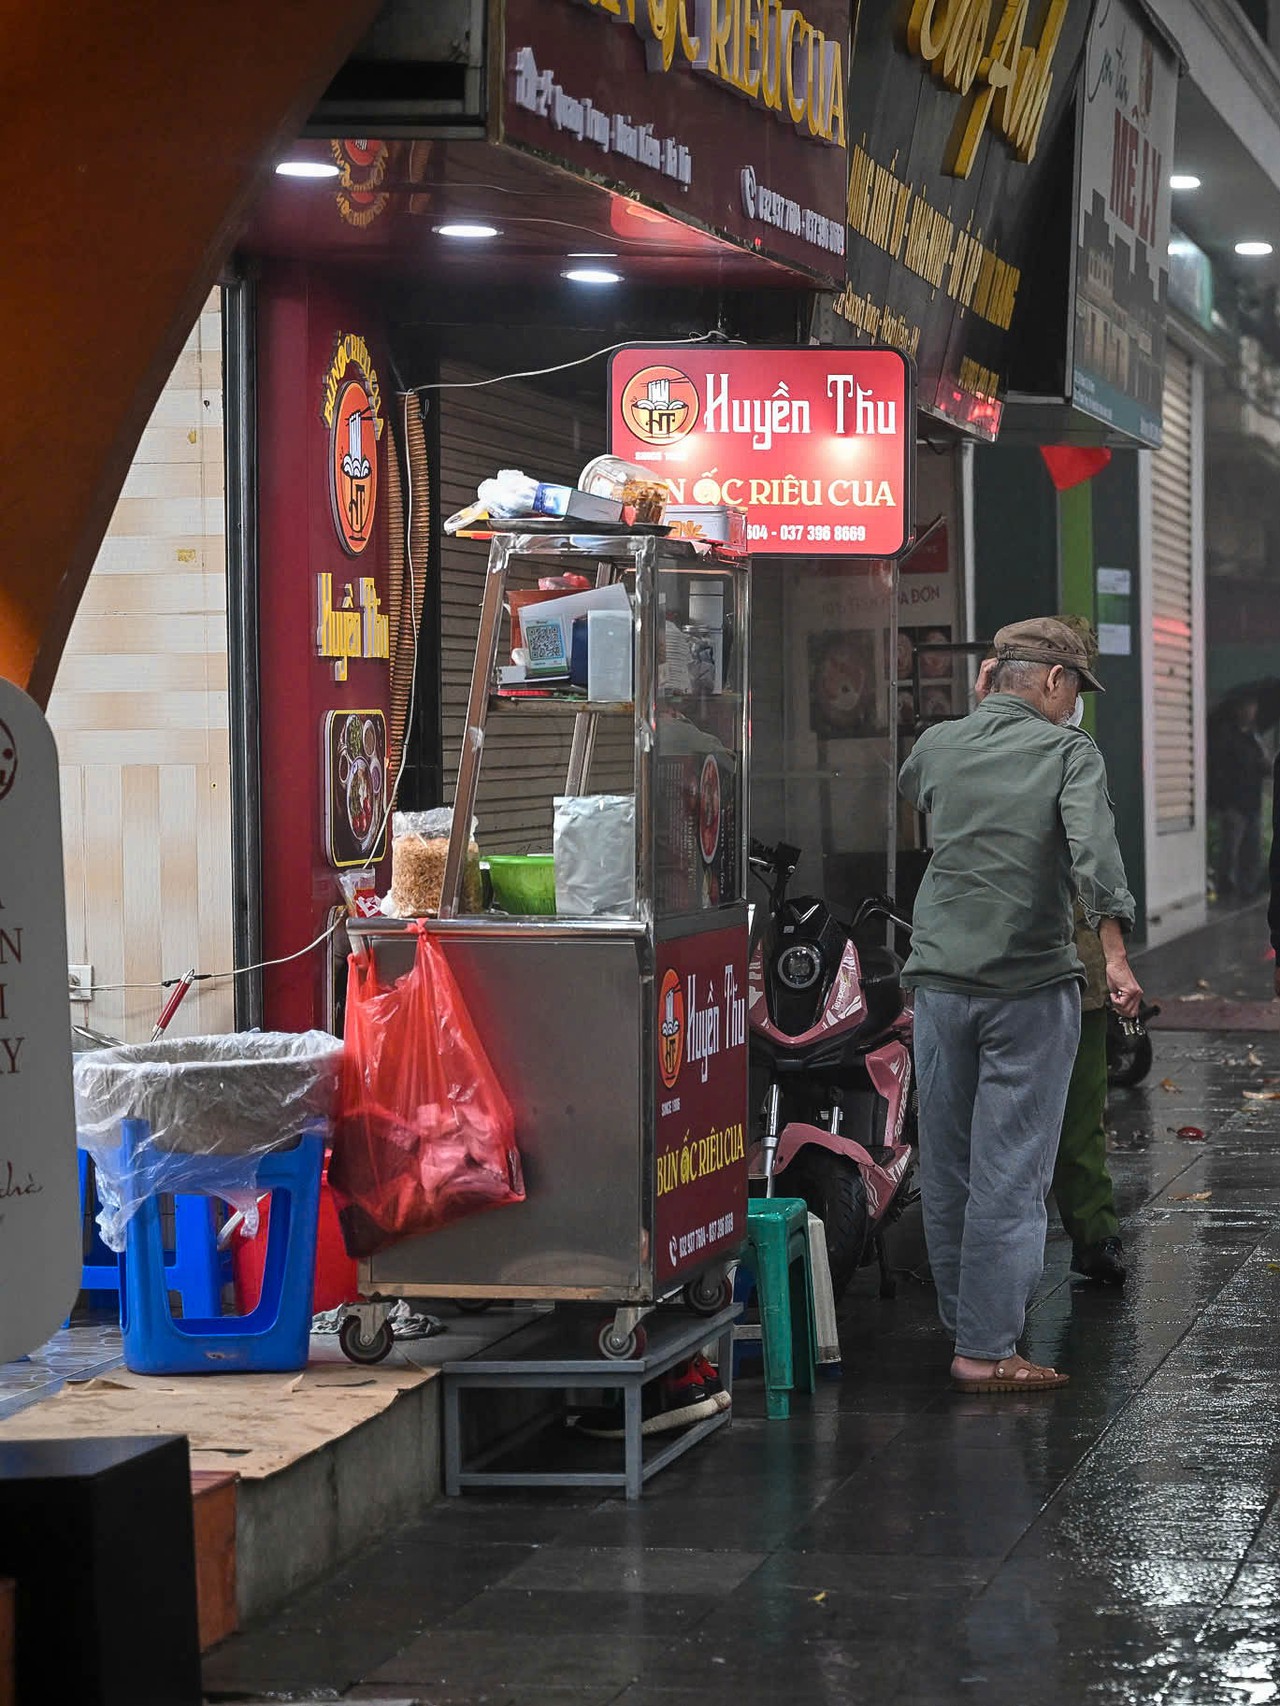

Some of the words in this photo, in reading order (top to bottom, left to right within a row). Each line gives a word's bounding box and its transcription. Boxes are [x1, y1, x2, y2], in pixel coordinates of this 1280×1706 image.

[786, 10, 846, 148] CUA
[703, 374, 811, 450] Huyền
[827, 374, 898, 435] Thu
[750, 474, 821, 506] RIÊU
[828, 480, 897, 507] CUA
[746, 525, 768, 541] 604
[780, 525, 803, 541] 037
[687, 974, 720, 1083] Huyền
[724, 964, 745, 1050] Thu
[656, 1144, 679, 1197] BÚN
[681, 1128, 698, 1184] ỐC
[698, 1126, 724, 1178] RIÊU
[724, 1123, 745, 1168] CUA
